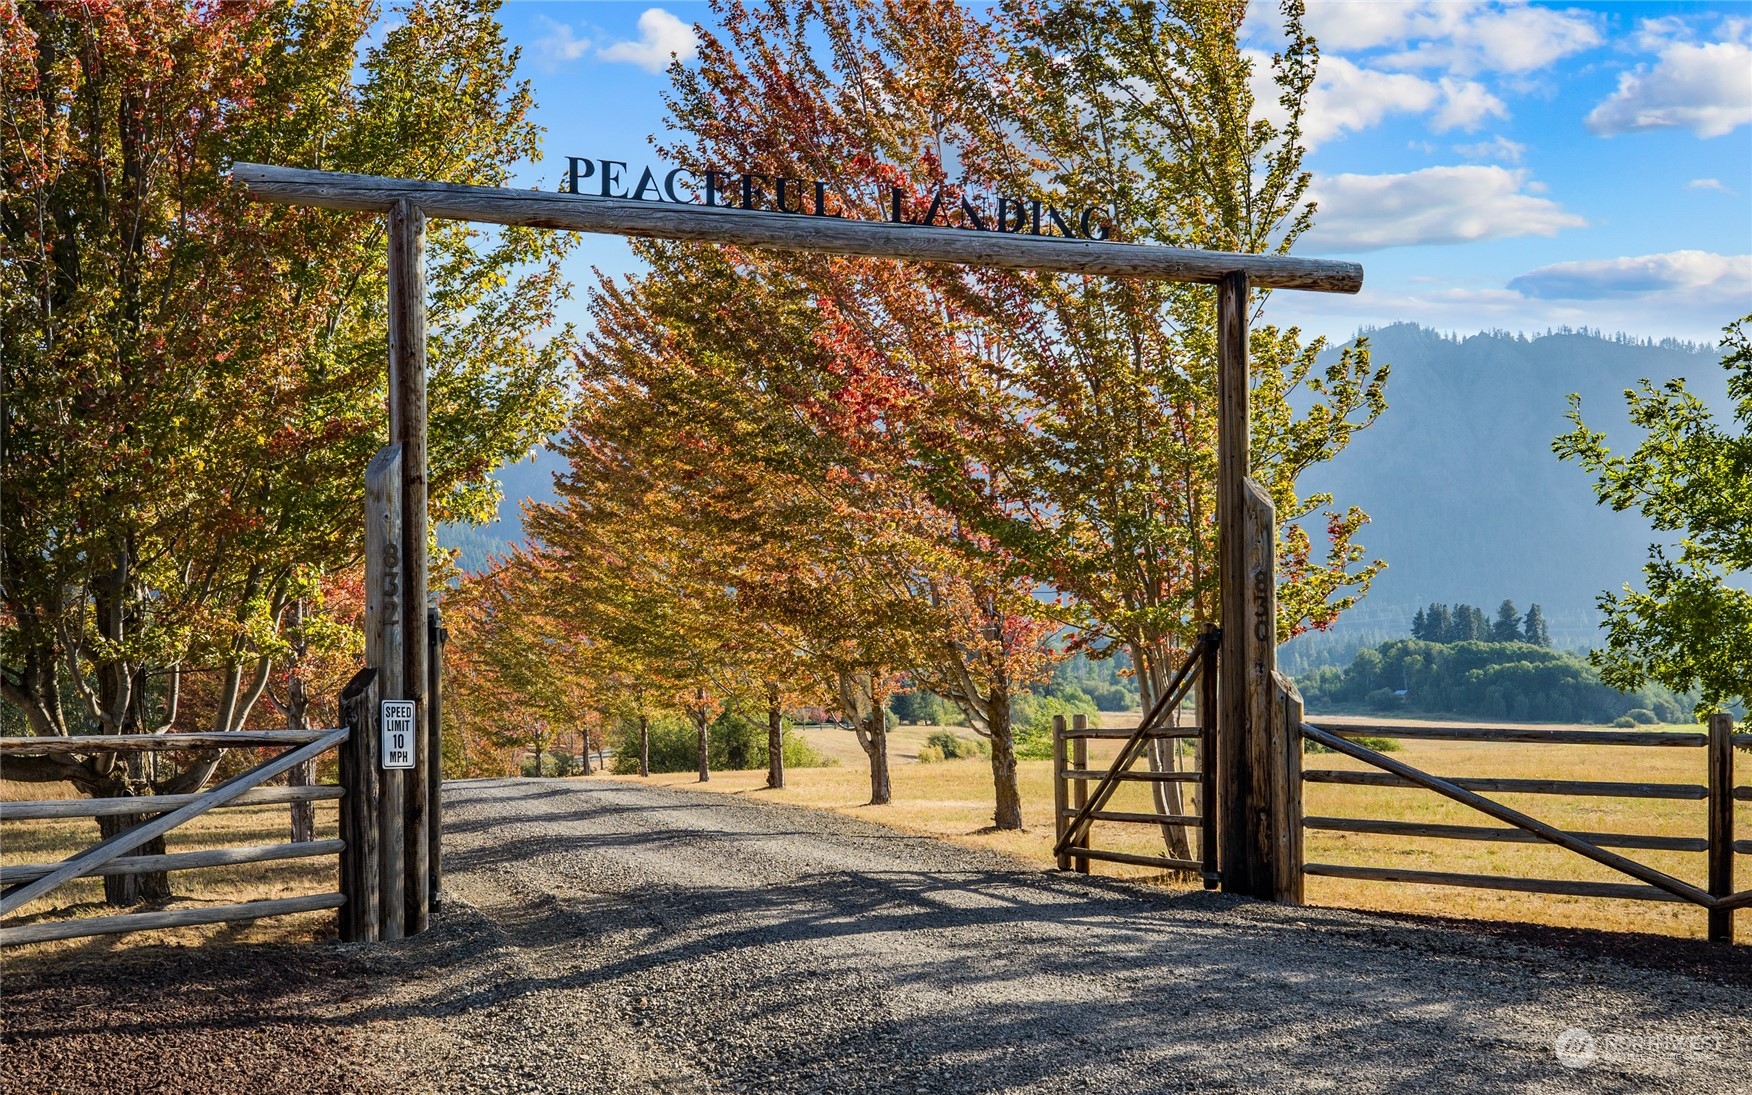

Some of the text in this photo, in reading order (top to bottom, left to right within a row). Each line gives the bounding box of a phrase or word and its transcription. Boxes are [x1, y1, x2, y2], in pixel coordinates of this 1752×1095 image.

[564, 155, 1111, 241] PEACEFUL LANDING
[383, 543, 399, 626] 832
[1254, 569, 1270, 642] 830
[385, 706, 412, 719] SPEED
[386, 719, 410, 732] LIMIT
[393, 734, 404, 749] 10
[389, 751, 408, 763] MPH
